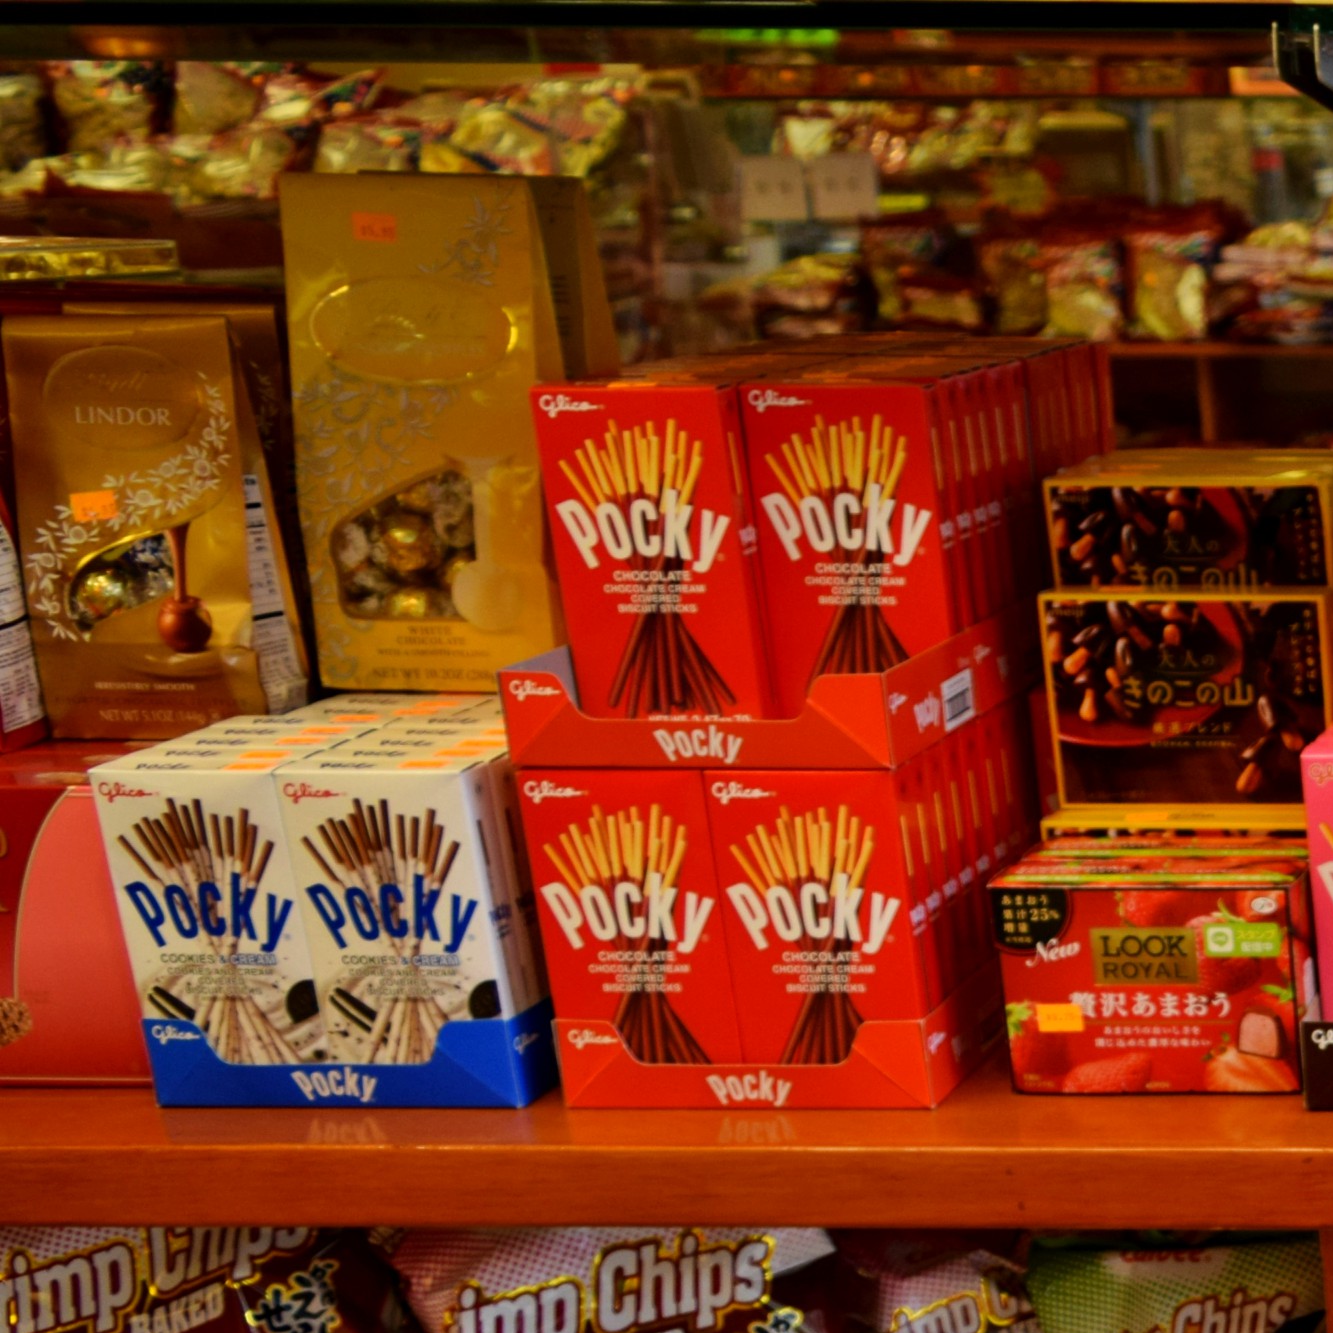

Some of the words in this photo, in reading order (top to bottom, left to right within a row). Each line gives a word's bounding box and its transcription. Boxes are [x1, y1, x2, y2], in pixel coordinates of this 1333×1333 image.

[75, 405, 171, 427] LINDOR
[555, 488, 731, 573] Pocky
[761, 483, 931, 566] Pocky
[815, 563, 892, 574] CHOCOLATE
[1124, 678, 1253, 708] きのこの山
[125, 871, 294, 952] Pocky
[305, 872, 477, 952] Pocky
[160, 953, 215, 966] COOKIES
[231, 953, 278, 966] CREAM
[1025, 938, 1081, 967] New
[1100, 935, 1187, 958] LOOK
[1103, 962, 1189, 980] ROYAL
[705, 1070, 792, 1107] Pocky
